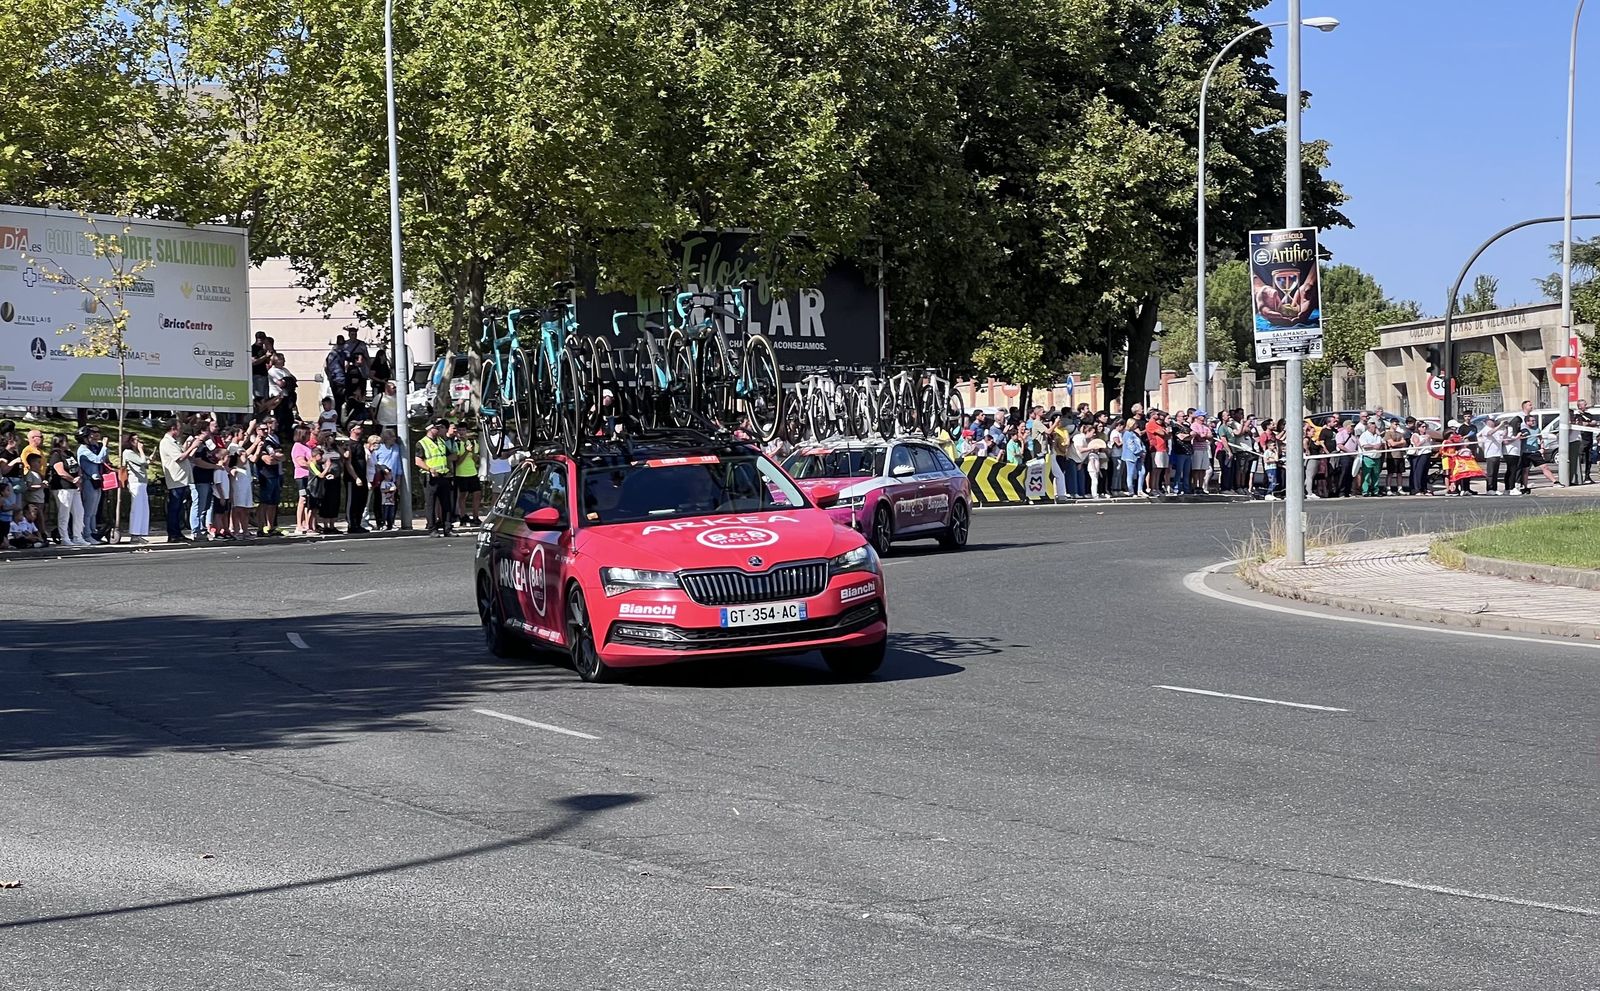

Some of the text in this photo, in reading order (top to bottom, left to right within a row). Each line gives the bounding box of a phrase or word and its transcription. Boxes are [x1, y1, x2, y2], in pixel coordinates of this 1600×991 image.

[45, 229, 72, 255] CON
[156, 238, 236, 268] SALMANTINO
[163, 319, 213, 331] BricoCentro
[773, 341, 827, 350] ACONSEJAMOS.
[205, 357, 235, 369] el pilar
[89, 381, 236, 401] www.salamancartvaldia.es
[642, 515, 800, 536] ARKEA
[709, 531, 767, 542] B&B
[719, 536, 765, 545] HOTELS
[500, 558, 528, 593] ARKEA
[840, 581, 876, 600] Bianchi
[619, 603, 677, 615] Bianchi
[730, 604, 797, 623] GT-354-AC
